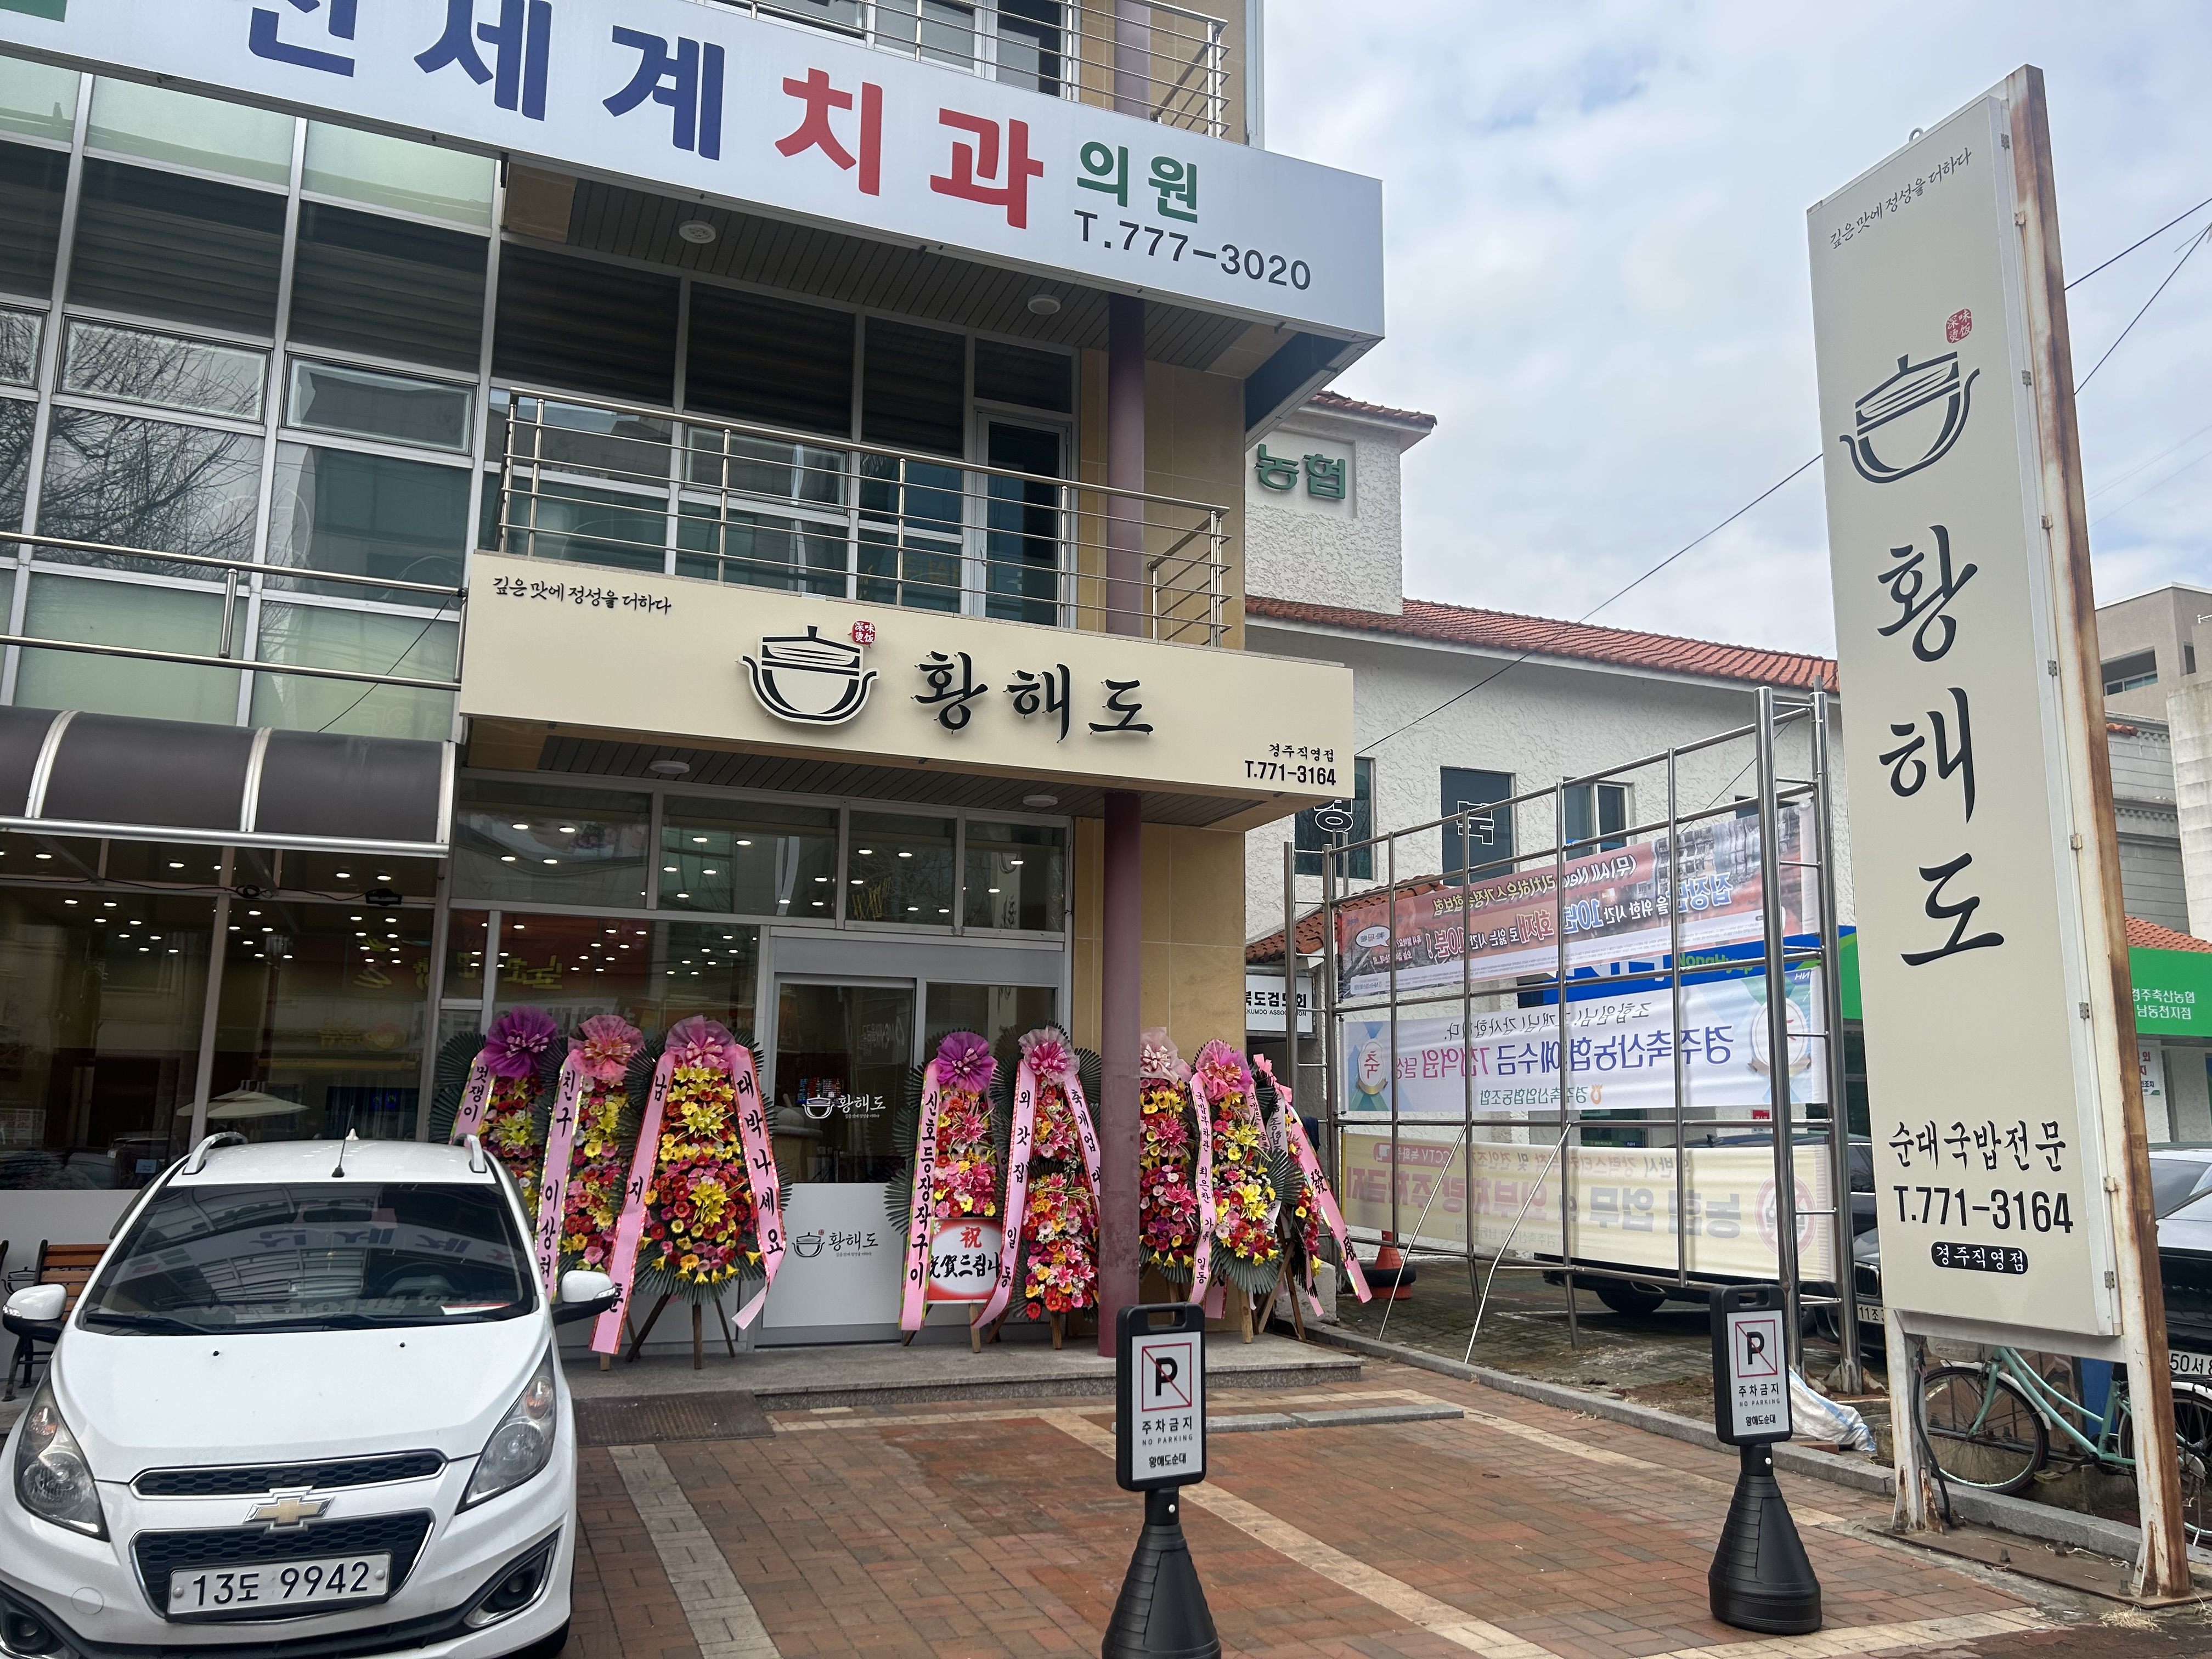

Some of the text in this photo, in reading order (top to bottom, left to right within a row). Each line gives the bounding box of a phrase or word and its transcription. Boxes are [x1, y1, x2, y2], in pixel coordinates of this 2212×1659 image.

[774, 67, 1043, 229] 치과
[1076, 140, 1198, 224] 의원
[1830, 147, 1972, 249] 깊은 맛에 정성을 더하다
[1073, 208, 1312, 291] T.777-3020
[1254, 444, 1346, 499] 농협
[493, 577, 673, 615] 깊은 맛에 정성을 더하다
[911, 651, 1154, 743] 황해도
[1268, 743, 1335, 763] 경주직영점
[1877, 524, 2004, 966] 황해도
[1244, 760, 1336, 786] T.771-3164
[2136, 1005, 2191, 1020] 남동천지점
[556, 1070, 575, 1138] 친구
[837, 1093, 886, 1114] 황해도
[736, 1070, 783, 1255] 대박나세요
[1889, 1120, 2066, 1172] 순대국밥전문
[1893, 1185, 2074, 1233] T.771-3164
[828, 1231, 878, 1251] 황해도
[960, 1226, 982, 1248] 祝
[1936, 1244, 2024, 1273] 경주직영점
[1747, 1331, 1764, 1365] P
[1155, 1357, 1178, 1396] P
[1739, 1383, 1779, 1398] 주차금지
[1752, 1398, 1780, 1407] PARKING
[1142, 1415, 1193, 1435] 주차금지
[1158, 1434, 1193, 1444] PARKING
[280, 1561, 369, 1599] 9942
